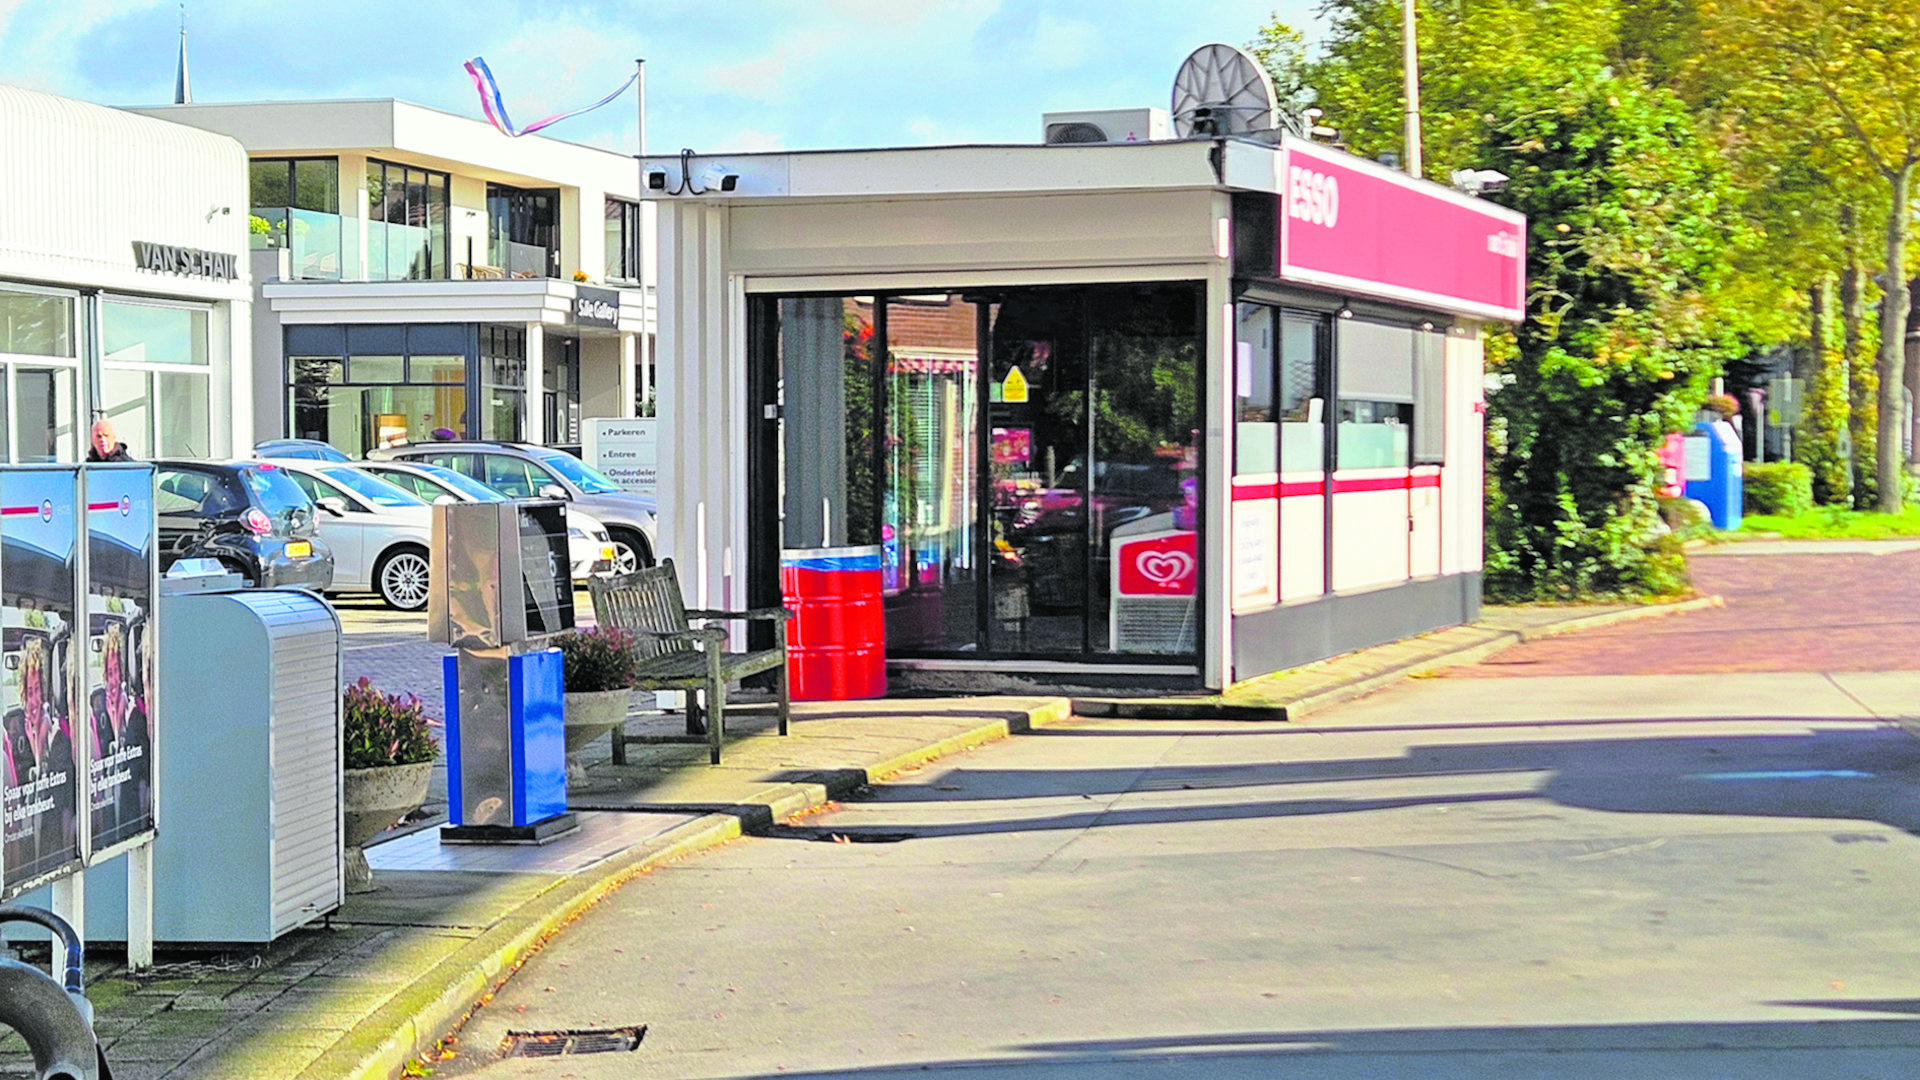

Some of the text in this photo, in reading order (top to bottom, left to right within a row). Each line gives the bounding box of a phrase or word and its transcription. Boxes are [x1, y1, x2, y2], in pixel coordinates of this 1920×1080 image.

[1289, 165, 1339, 229] ESSO
[132, 241, 239, 280] VAN SCHAIK
[594, 300, 618, 325] Gallery
[607, 428, 646, 436] Parkeren
[608, 450, 637, 458] Entree
[126, 745, 143, 760] Extras
[4, 785, 22, 805] Spaar
[22, 781, 35, 796] voor
[49, 770, 67, 787] Extras
[4, 806, 13, 828] bij
[13, 804, 26, 822] elke
